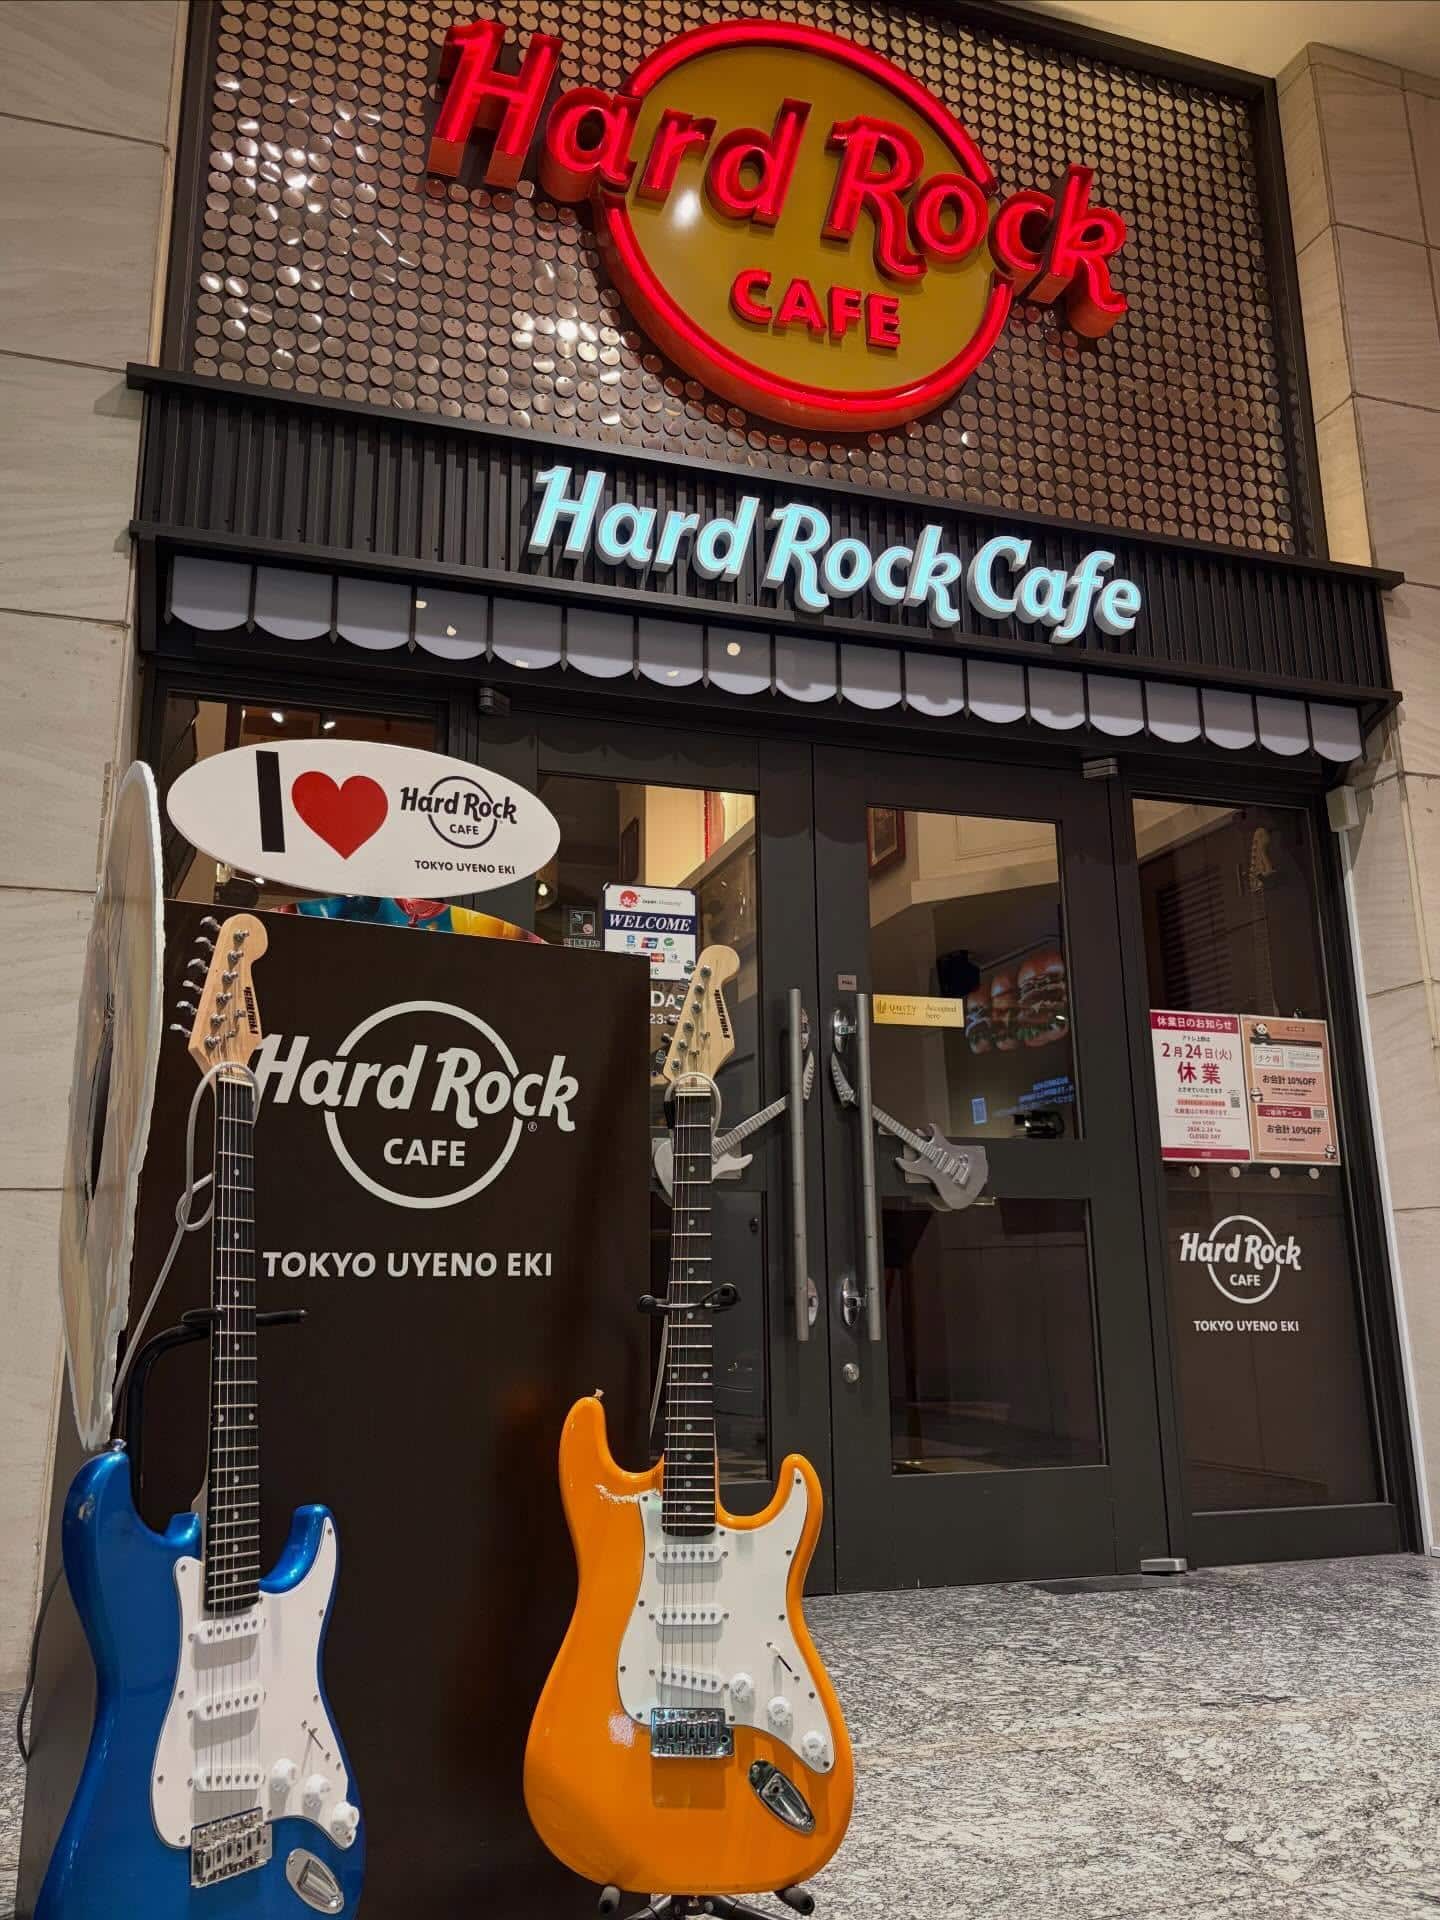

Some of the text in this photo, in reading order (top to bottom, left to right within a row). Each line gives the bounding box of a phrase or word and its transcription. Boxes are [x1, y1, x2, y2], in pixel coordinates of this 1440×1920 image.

[426, 18, 1127, 336] Hard Rock
[730, 268, 900, 350] CAFE
[529, 464, 1142, 644] Hard Rock Cafe
[255, 750, 286, 853] I
[400, 787, 518, 825] Hard Rock
[449, 823, 480, 836] CAFE
[414, 859, 516, 876] TOKYO UYENO EKI
[609, 913, 692, 932] WELCOME
[1156, 1015, 1233, 1030] 休業日のお知らせ
[252, 1033, 580, 1132] Hard Rock
[1177, 1061, 1222, 1085] 休業
[383, 1137, 466, 1167] CAFE
[262, 1251, 553, 1278] TOKYO UYENO EKI
[1180, 1232, 1302, 1270] Hard Rock
[1229, 1273, 1261, 1287] CAFE
[1193, 1320, 1300, 1332] TOKYO UYENO EKI
